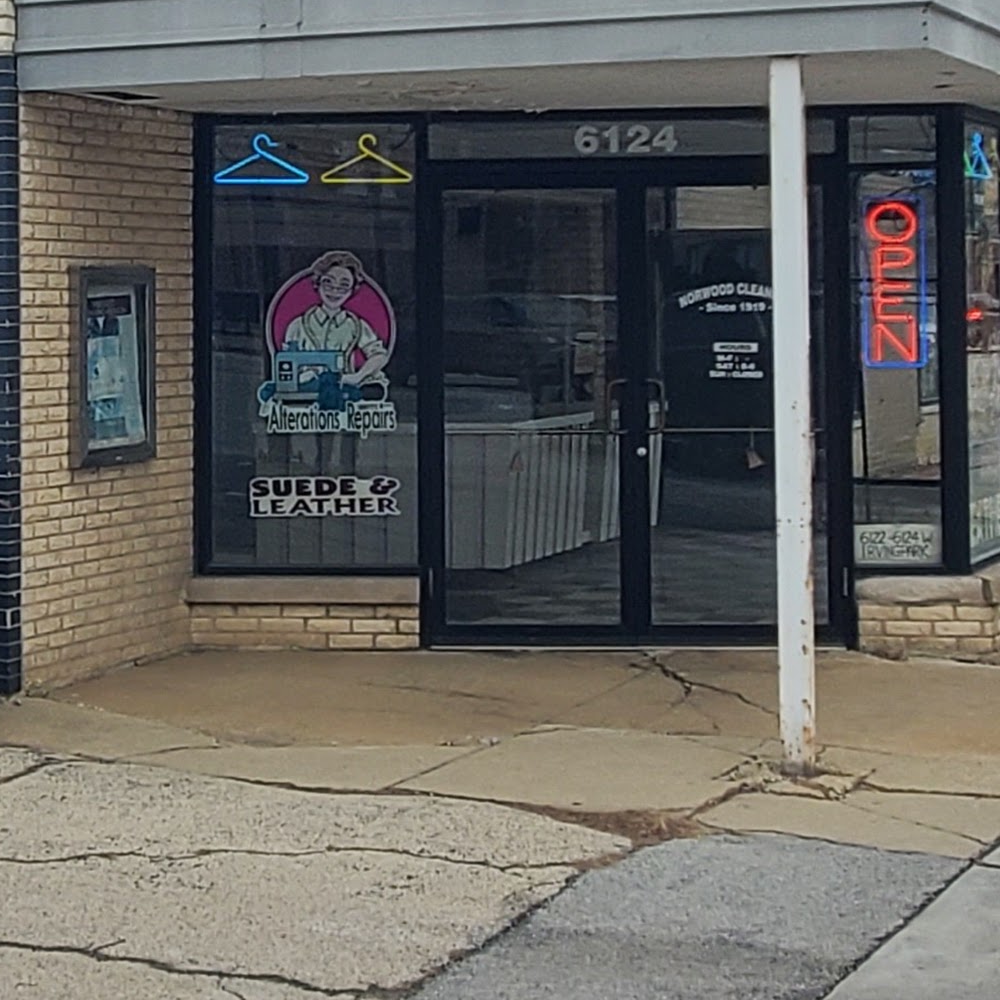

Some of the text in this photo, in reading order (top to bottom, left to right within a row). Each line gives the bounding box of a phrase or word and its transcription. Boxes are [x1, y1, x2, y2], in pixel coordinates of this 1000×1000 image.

[574, 125, 678, 154] 6124
[678, 281, 773, 308] NORWOOD CLEAN
[865, 201, 918, 362] OPEN
[705, 302, 737, 312] Since
[269, 402, 395, 437] Alterations Repairs
[251, 477, 398, 497] SUEDE &
[252, 498, 397, 515] LEATHER
